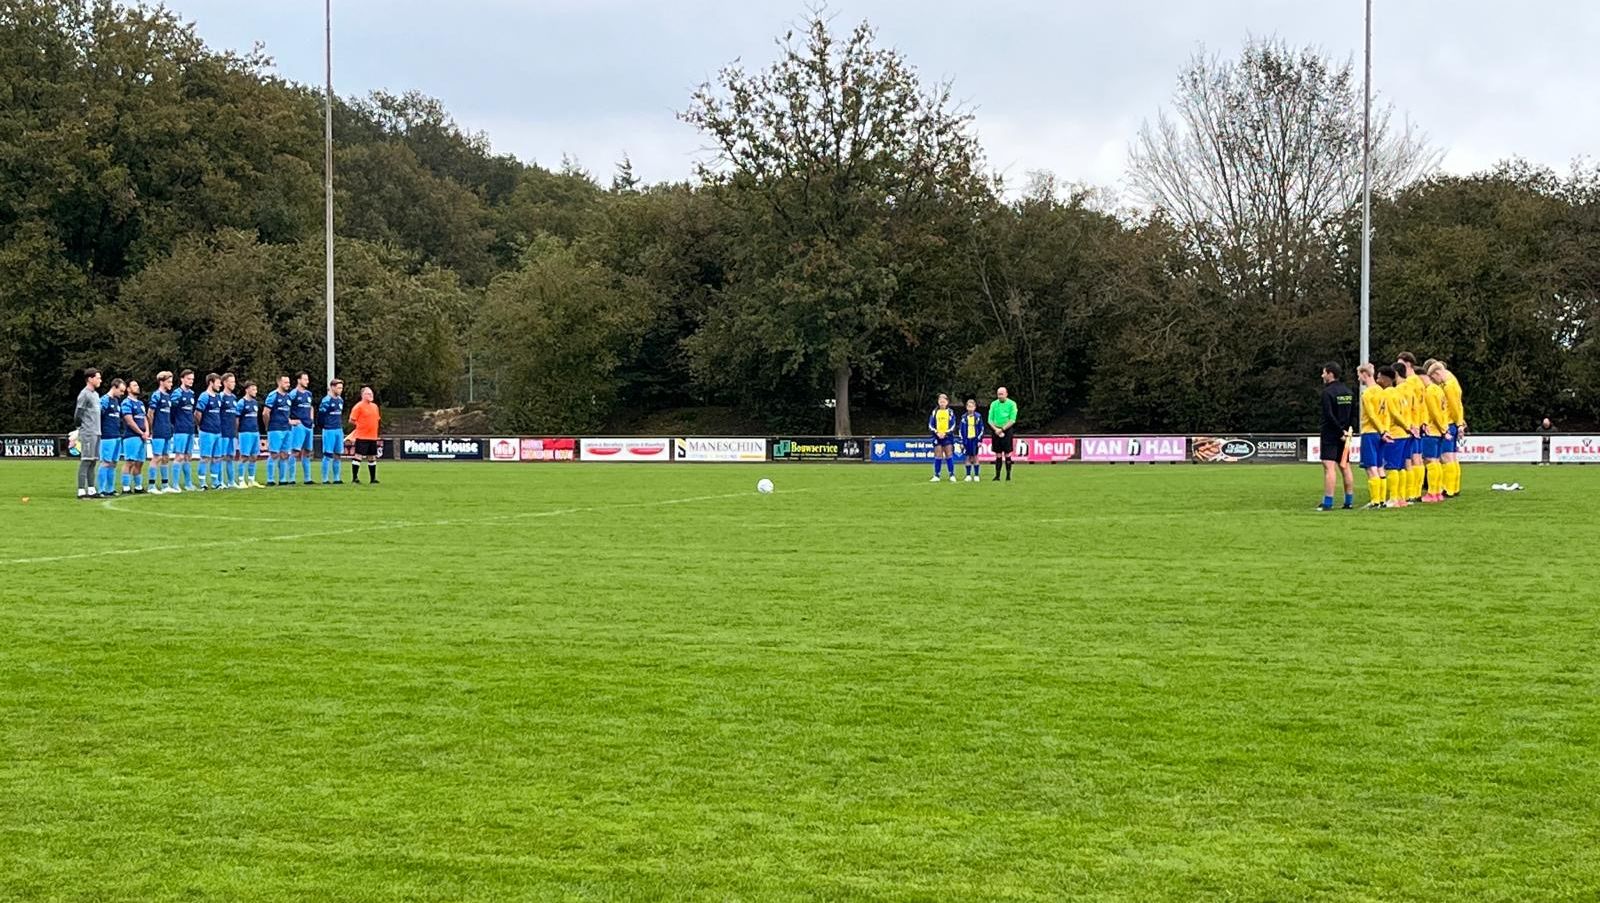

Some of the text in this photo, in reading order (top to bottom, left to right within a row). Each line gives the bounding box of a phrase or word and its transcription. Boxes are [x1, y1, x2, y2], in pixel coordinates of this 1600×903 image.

[5, 445, 54, 456] KREMER
[404, 440, 478, 453] Phone House
[1034, 440, 1074, 455] heun
[1085, 440, 1122, 454] VAN
[1146, 440, 1182, 454] HAL
